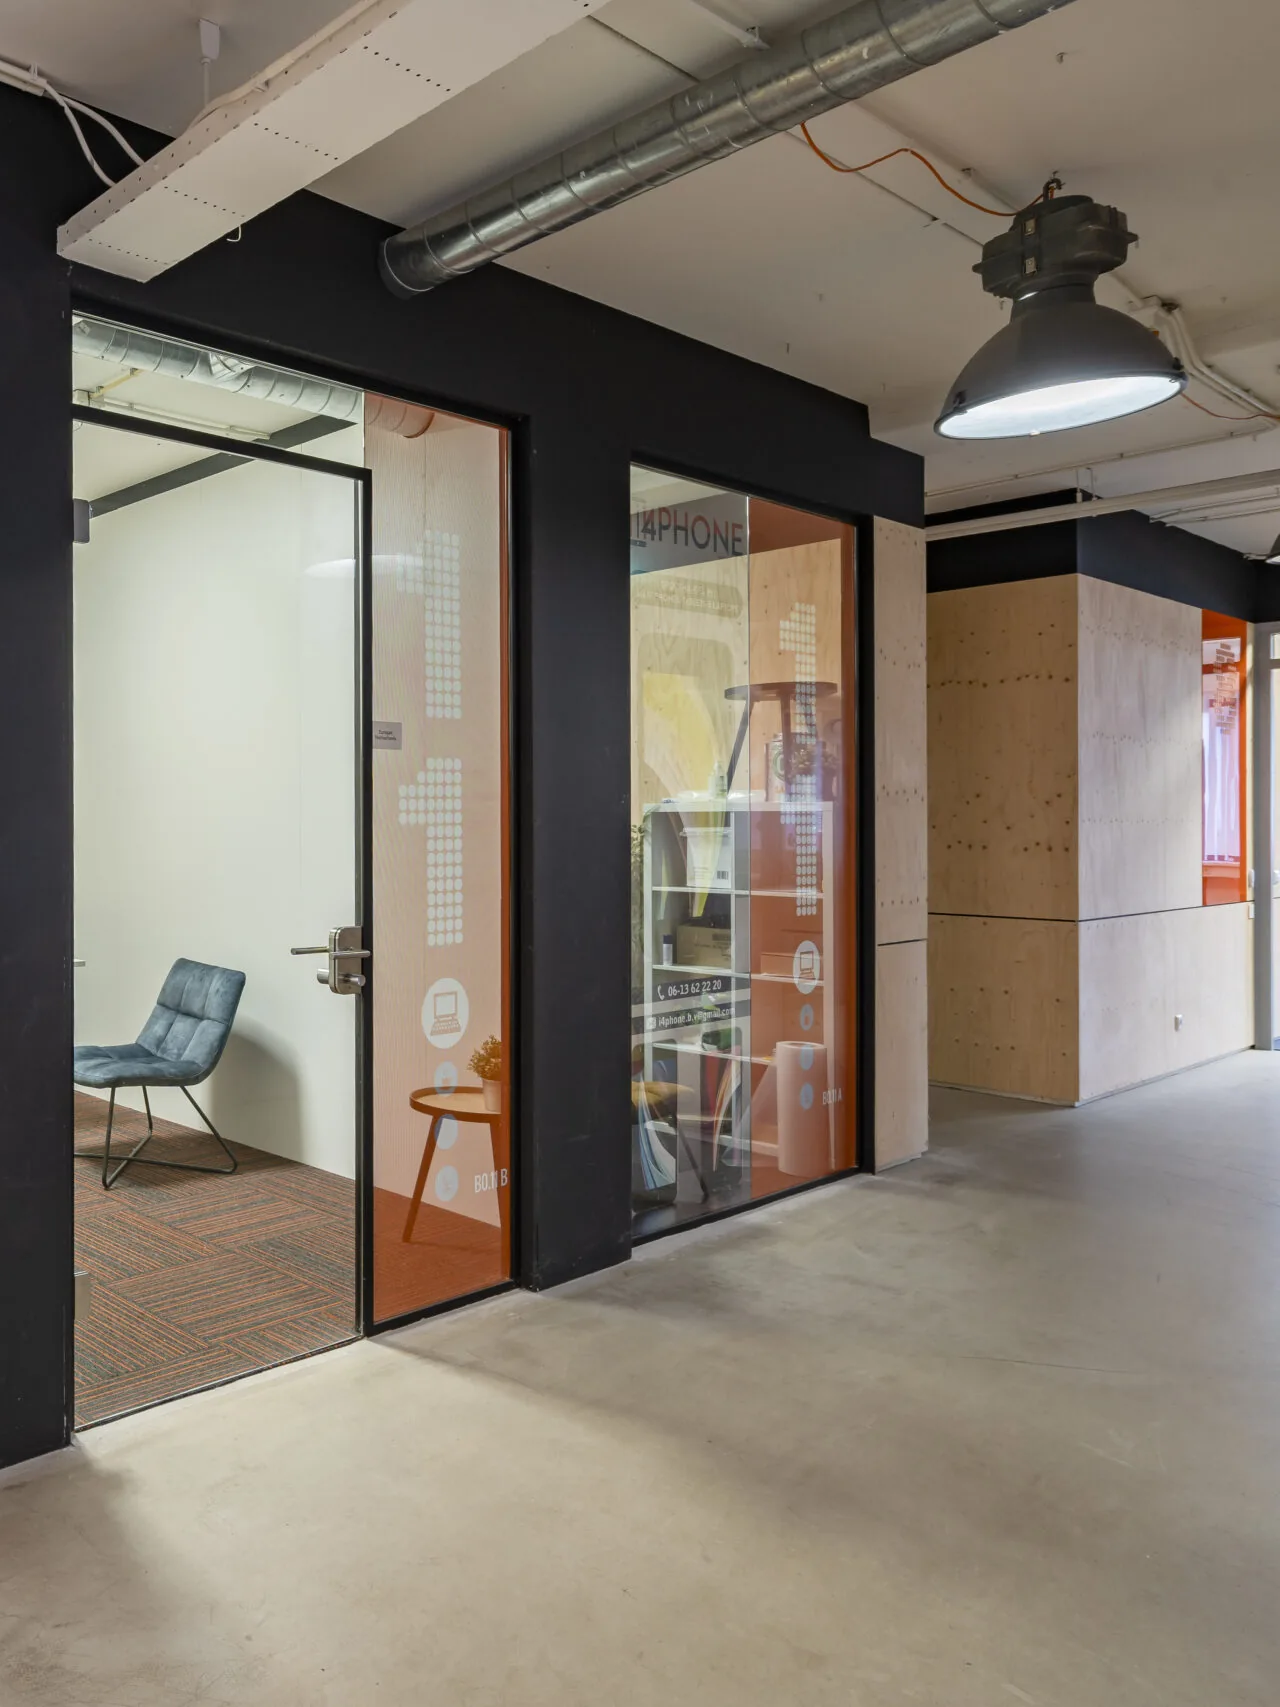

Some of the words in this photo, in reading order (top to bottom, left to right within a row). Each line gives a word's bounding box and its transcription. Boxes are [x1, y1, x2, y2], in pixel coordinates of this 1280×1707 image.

[667, 983, 690, 997] 06-13
[690, 982, 700, 994] 62
[701, 981, 711, 992] 22
[712, 979, 722, 990] 20
[500, 1168, 508, 1187] B
